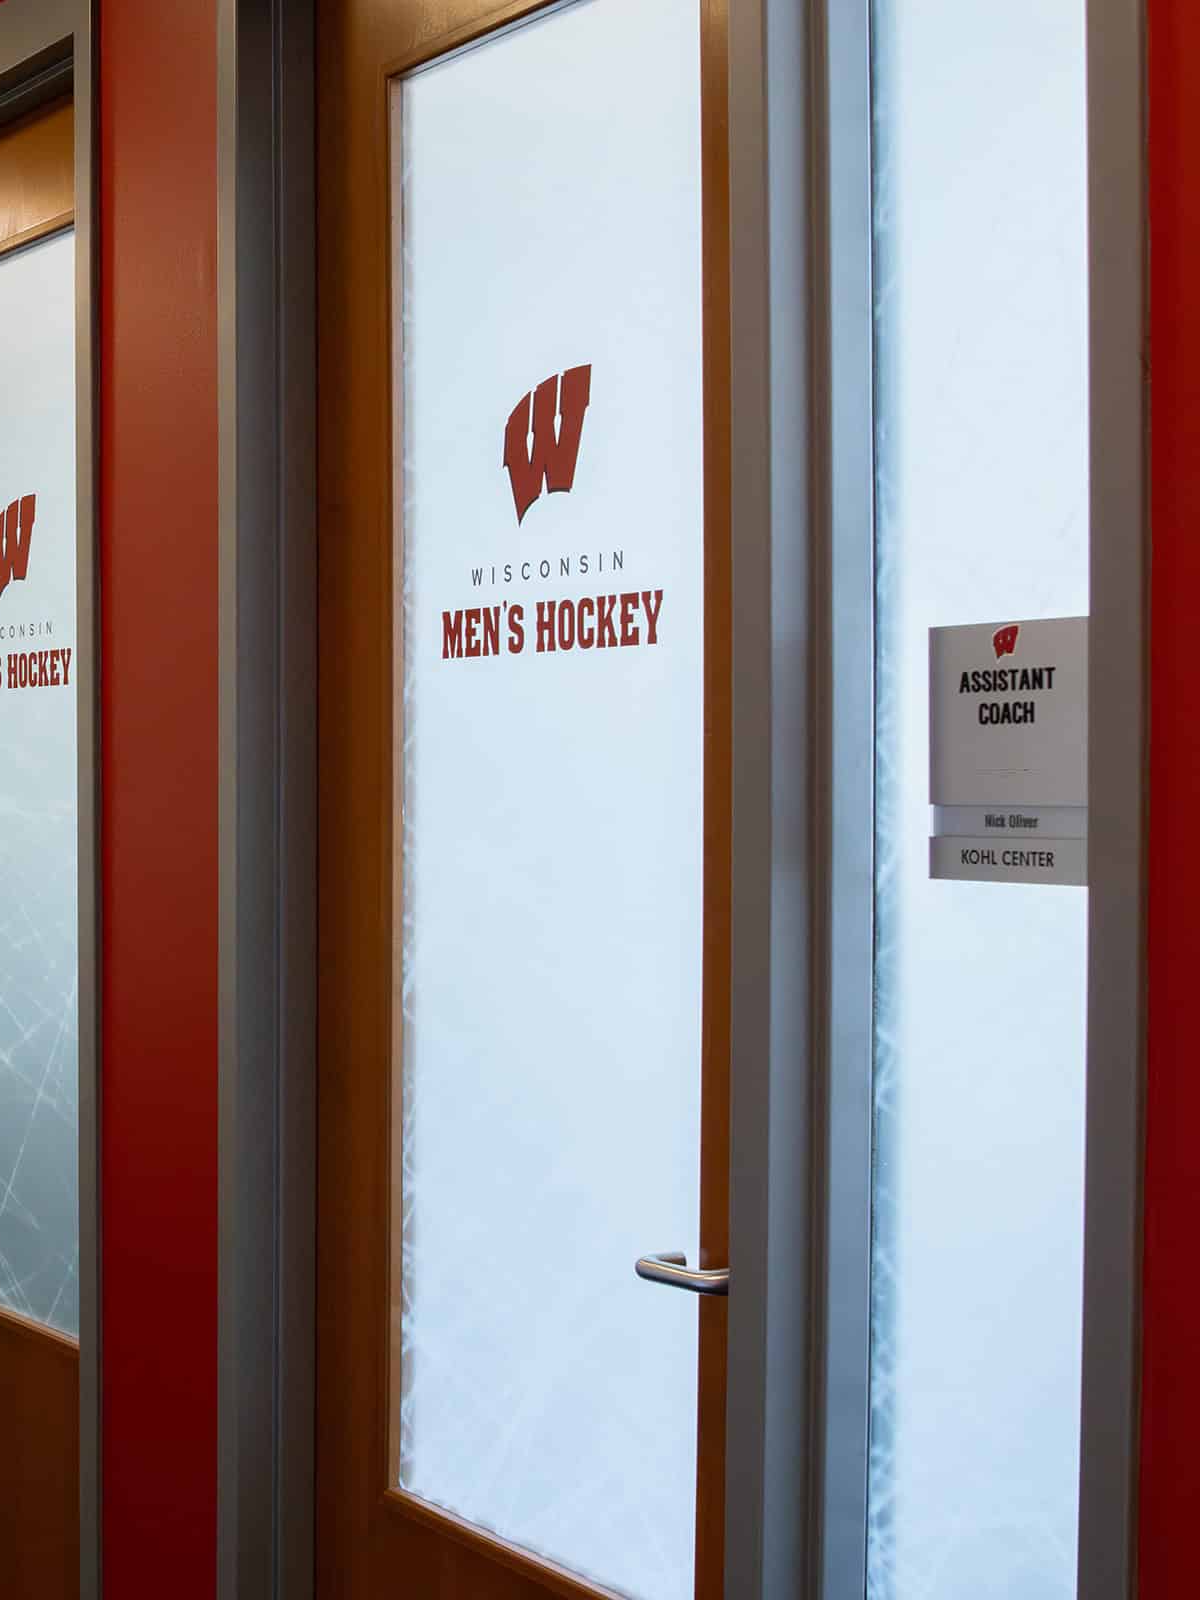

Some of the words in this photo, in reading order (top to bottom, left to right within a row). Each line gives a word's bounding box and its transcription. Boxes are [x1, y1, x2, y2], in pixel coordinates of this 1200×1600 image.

[471, 551, 624, 586] WISCONSIN
[442, 600, 524, 659] MEN'S
[536, 589, 664, 653] HOCKEY
[7, 648, 71, 689] HOCKEY
[959, 667, 1056, 693] ASSISTANT
[978, 701, 1035, 725] COACH
[984, 814, 1006, 828] Nick
[1008, 814, 1039, 828] Oliver
[961, 849, 998, 865] KOHL
[1002, 850, 1054, 867] CENTER
